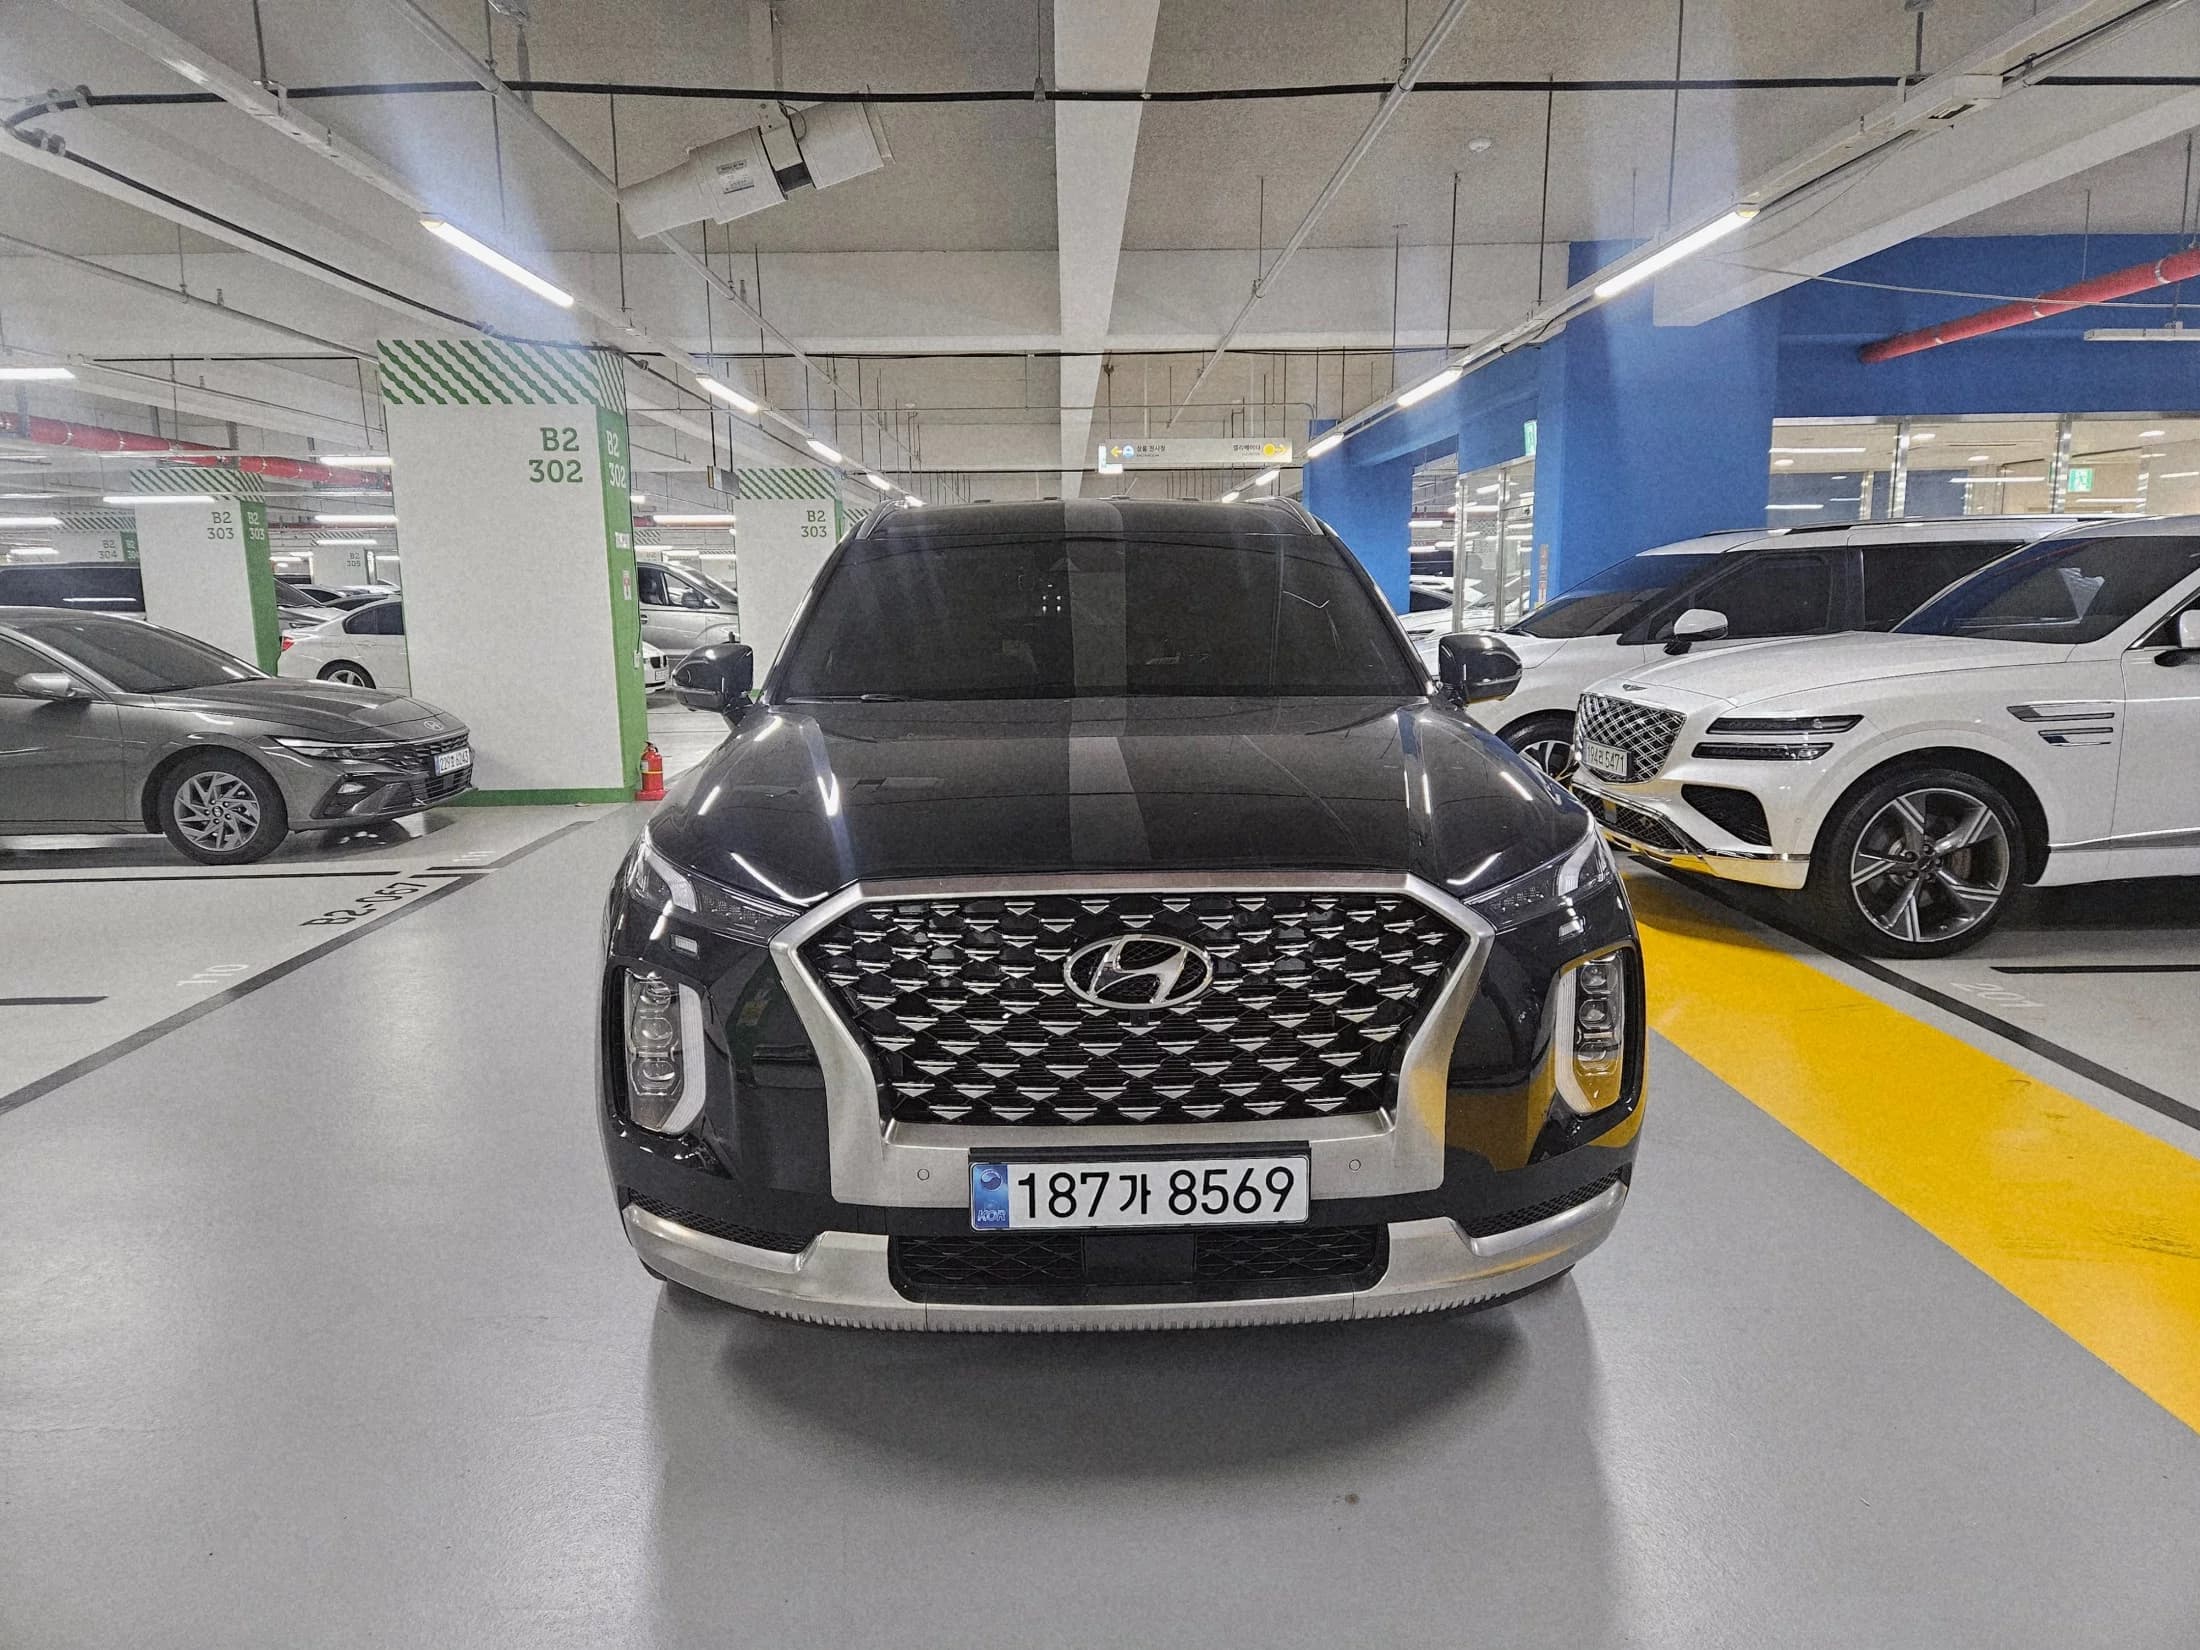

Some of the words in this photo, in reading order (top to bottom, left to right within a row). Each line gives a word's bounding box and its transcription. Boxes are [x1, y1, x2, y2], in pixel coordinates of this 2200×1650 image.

[540, 427, 579, 452] B2
[606, 430, 620, 457] B2
[528, 459, 583, 483] 302
[609, 462, 627, 488] 302
[211, 511, 232, 524] B2
[247, 511, 260, 525] B2
[806, 510, 826, 522] B2
[207, 527, 234, 540] 303
[249, 527, 265, 540] 303
[801, 525, 827, 538] 303
[103, 540, 116, 549] B2
[97, 550, 118, 559] 304
[1605, 750, 1625, 774] 5471
[299, 882, 428, 926] B2-067
[175, 963, 248, 986] 110
[1949, 982, 2045, 1007] 201
[1018, 1171, 1152, 1219] 187가
[1168, 1165, 1295, 1216] 8569
[977, 1208, 1007, 1222] KOR
